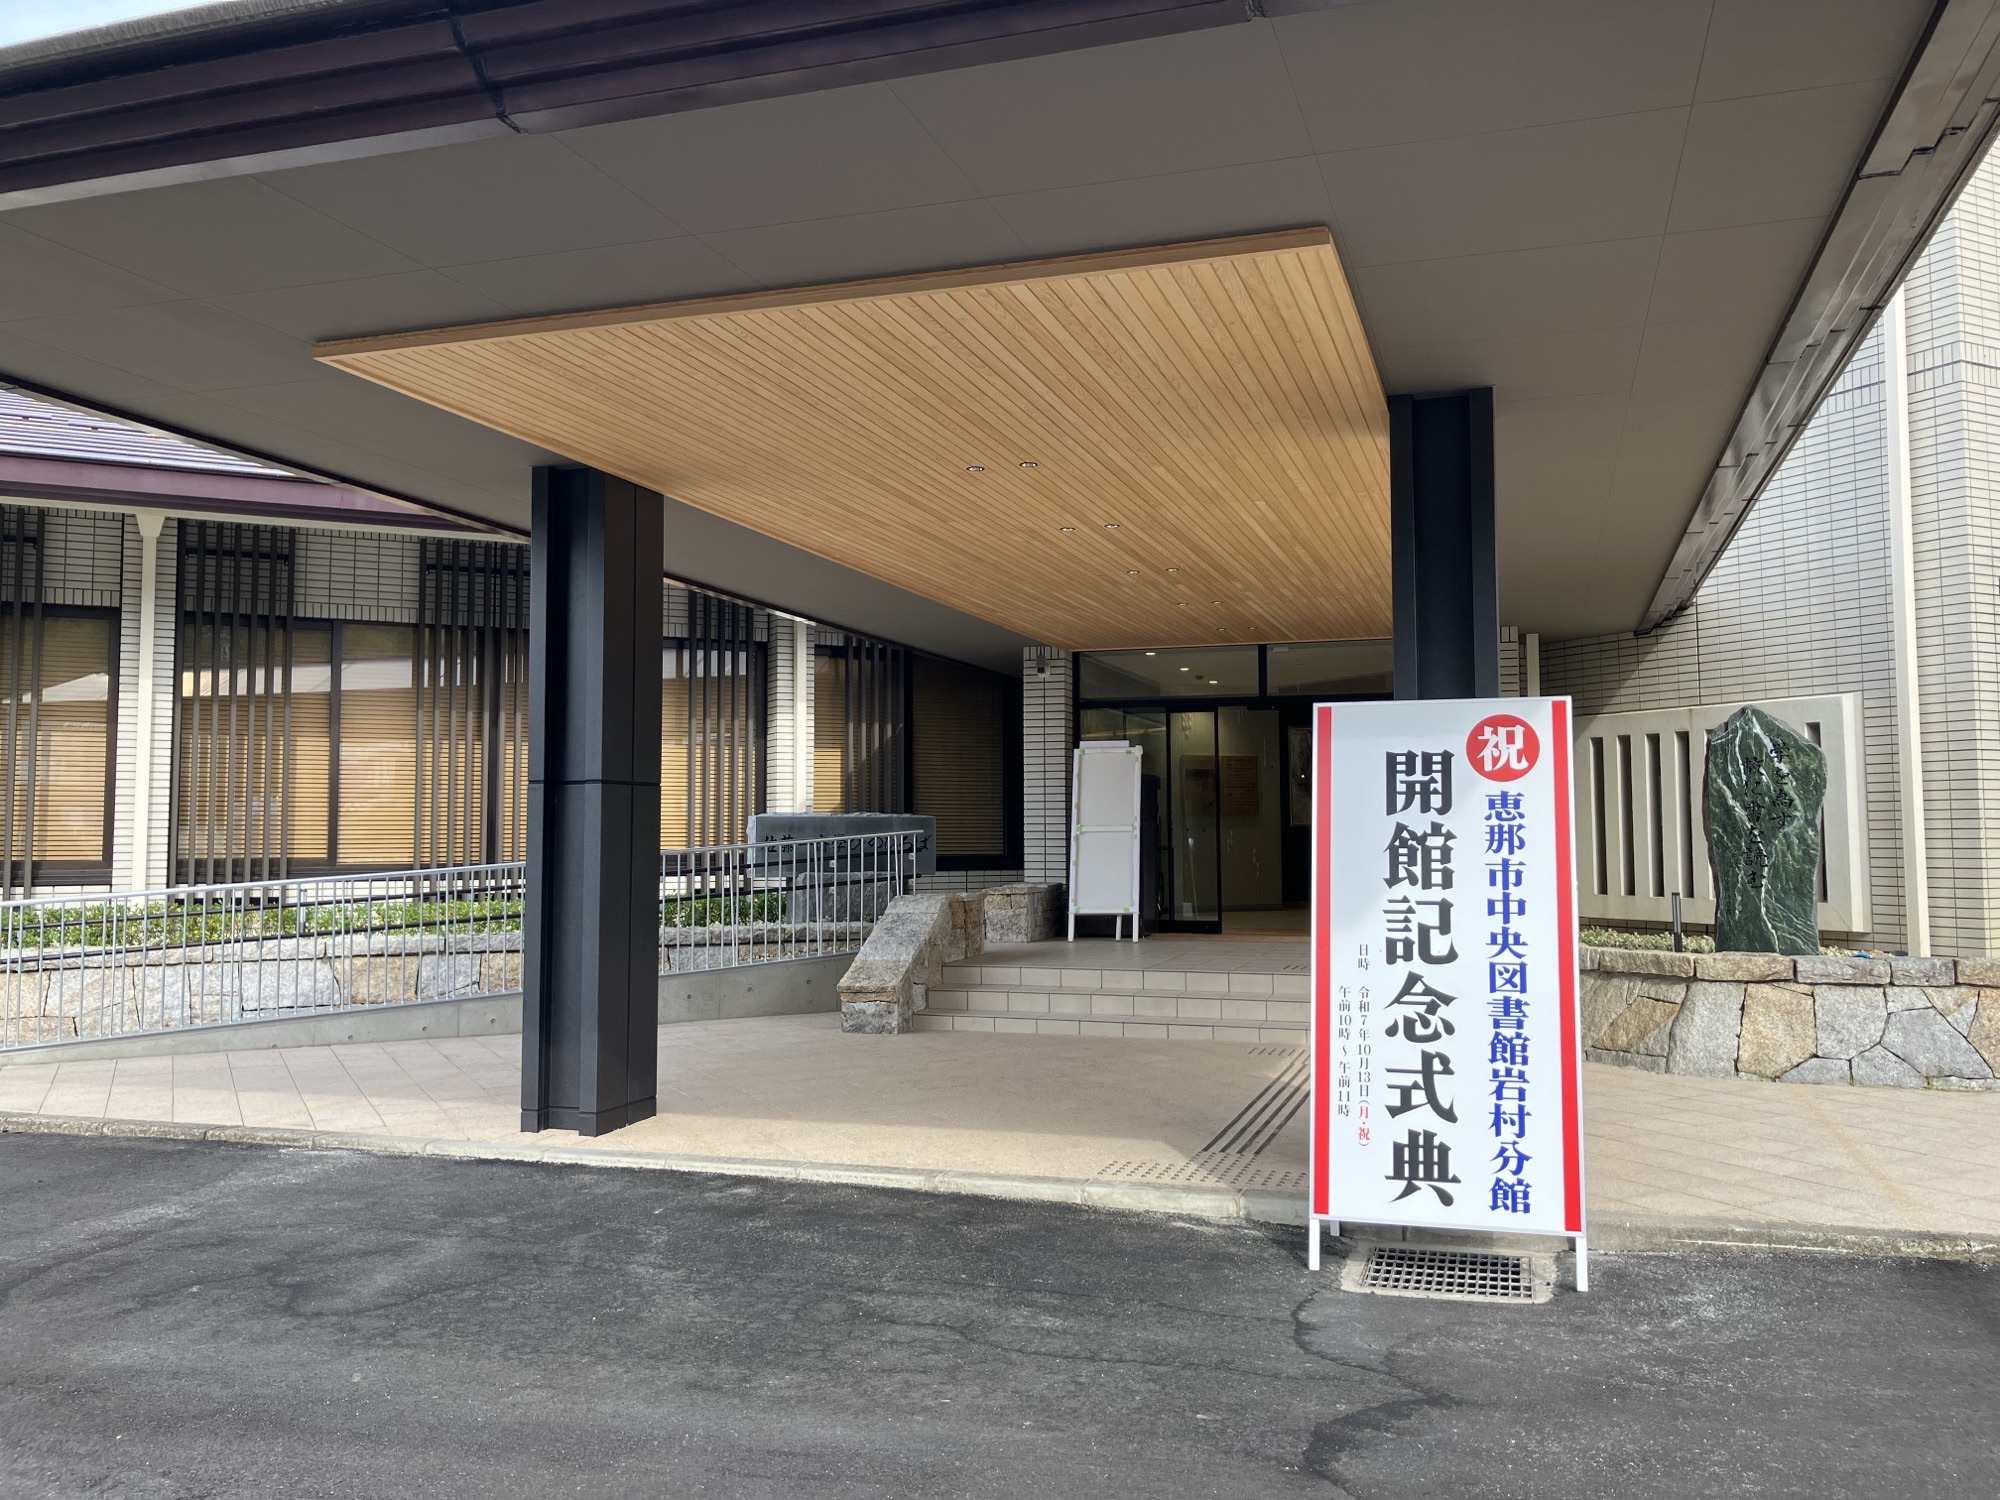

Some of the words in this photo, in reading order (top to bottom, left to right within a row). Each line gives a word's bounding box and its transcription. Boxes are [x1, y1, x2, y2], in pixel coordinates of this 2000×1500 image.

[1476, 723, 1529, 772] 祝
[1357, 944, 1370, 970] 日時
[1382, 749, 1462, 1207] 開館記念式典
[1483, 790, 1533, 1214] 恵那市中央図書館岩村分館
